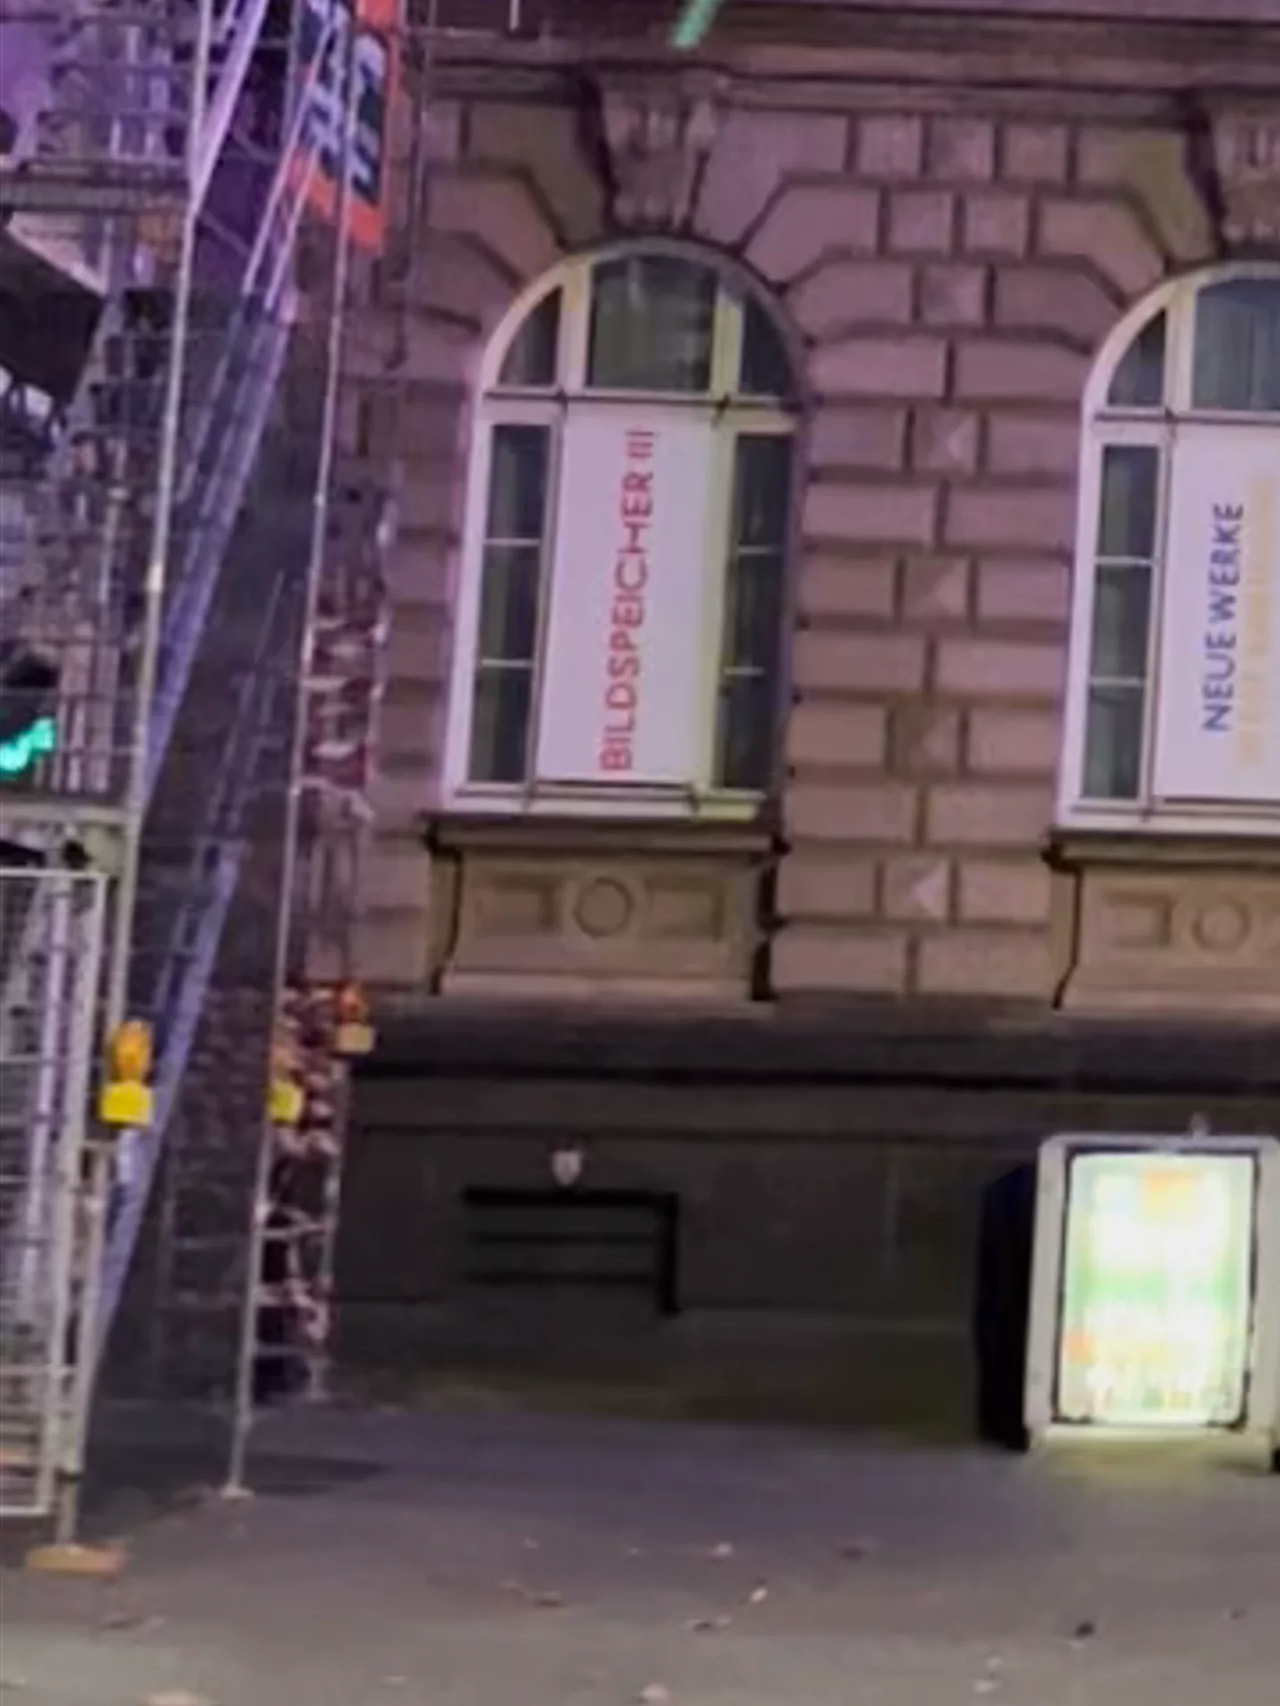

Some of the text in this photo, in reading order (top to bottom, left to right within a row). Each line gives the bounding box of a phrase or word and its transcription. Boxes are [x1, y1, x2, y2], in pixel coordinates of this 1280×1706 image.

[599, 470, 655, 771] BILDSPEICHER
[1202, 502, 1245, 733] NEUE WERKE
